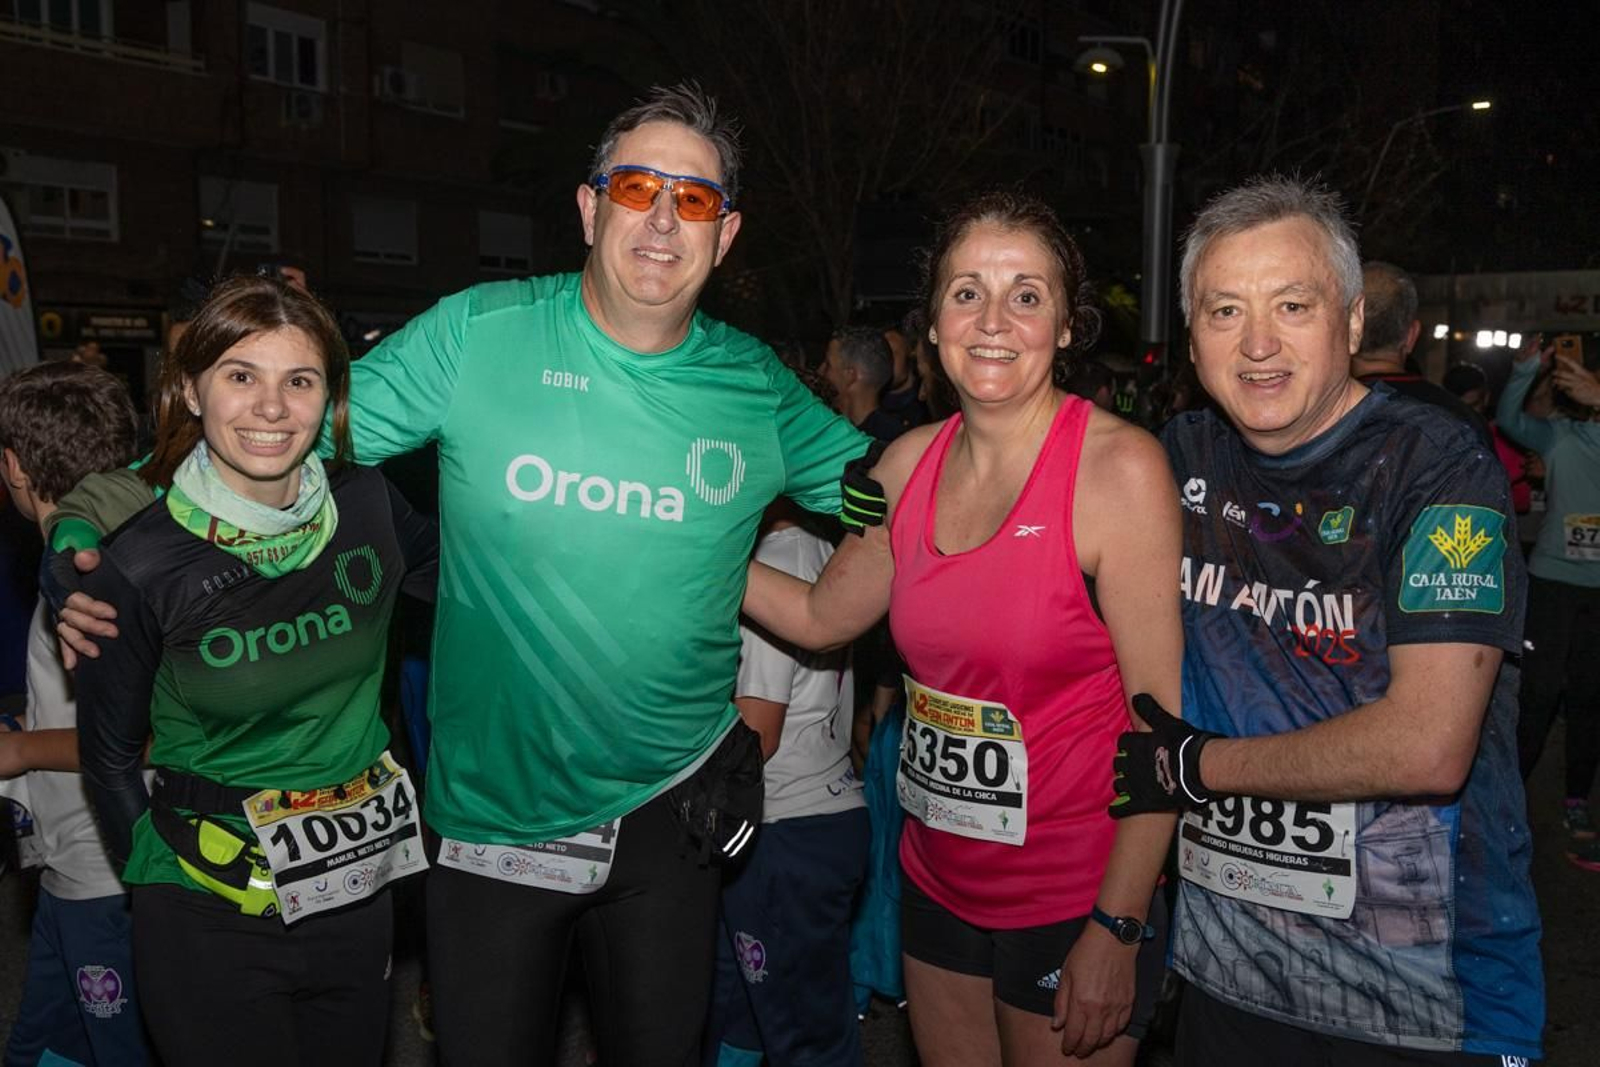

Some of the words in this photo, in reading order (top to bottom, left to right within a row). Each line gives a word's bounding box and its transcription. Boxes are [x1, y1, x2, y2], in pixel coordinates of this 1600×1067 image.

[542, 369, 590, 393] GOBIK
[506, 454, 685, 522] Orona
[1409, 572, 1447, 588] CAJA
[1452, 572, 1498, 588] RURAL
[199, 604, 352, 668] Orona
[1293, 623, 1362, 666] 2025
[905, 718, 1010, 788] 5350
[963, 789, 973, 798] LA
[974, 792, 997, 801] CHICA
[270, 781, 413, 863] 10034
[1199, 796, 1335, 853] 4985
[326, 851, 356, 868] MANUEL
[1228, 842, 1264, 859] HIGUERAS
[1265, 852, 1309, 866] HIGUERAS
